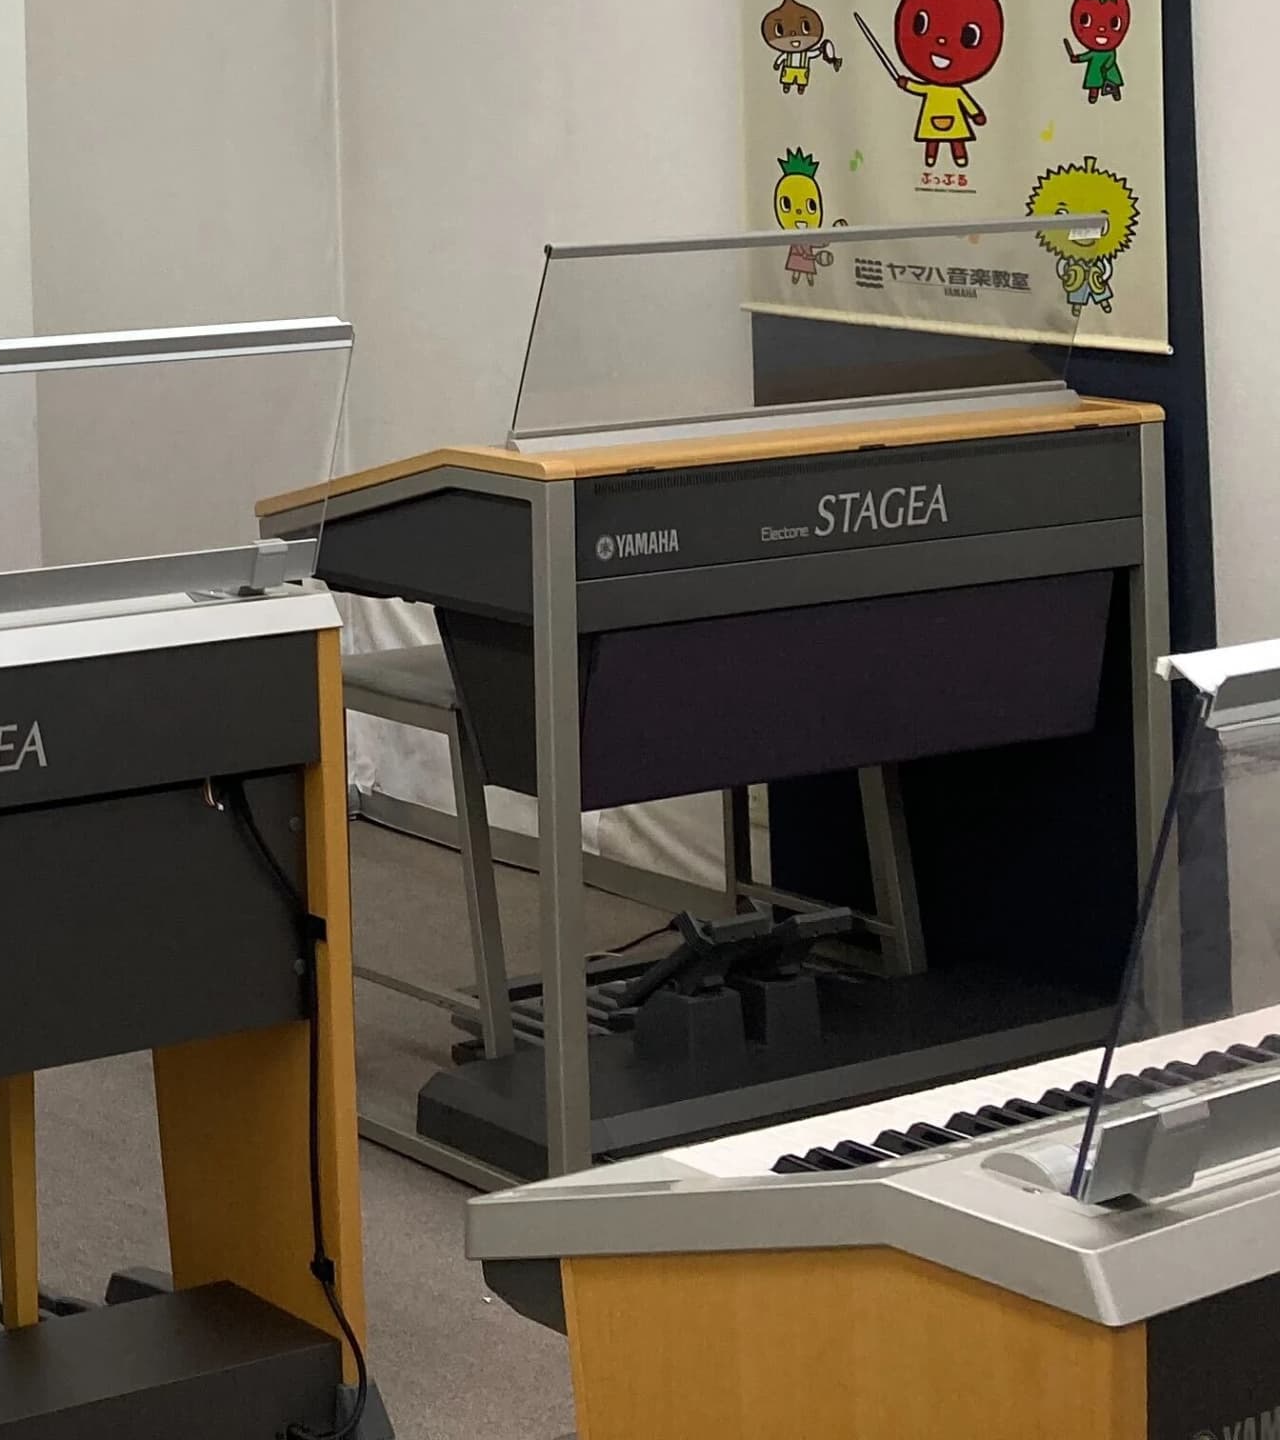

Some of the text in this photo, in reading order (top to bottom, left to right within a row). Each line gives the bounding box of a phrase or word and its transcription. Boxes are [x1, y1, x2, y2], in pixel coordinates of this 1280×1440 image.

[886, 262, 1032, 291] ヤマハ音楽教室
[760, 483, 949, 542] Electone STAGEA
[616, 528, 680, 559] YAMAHA
